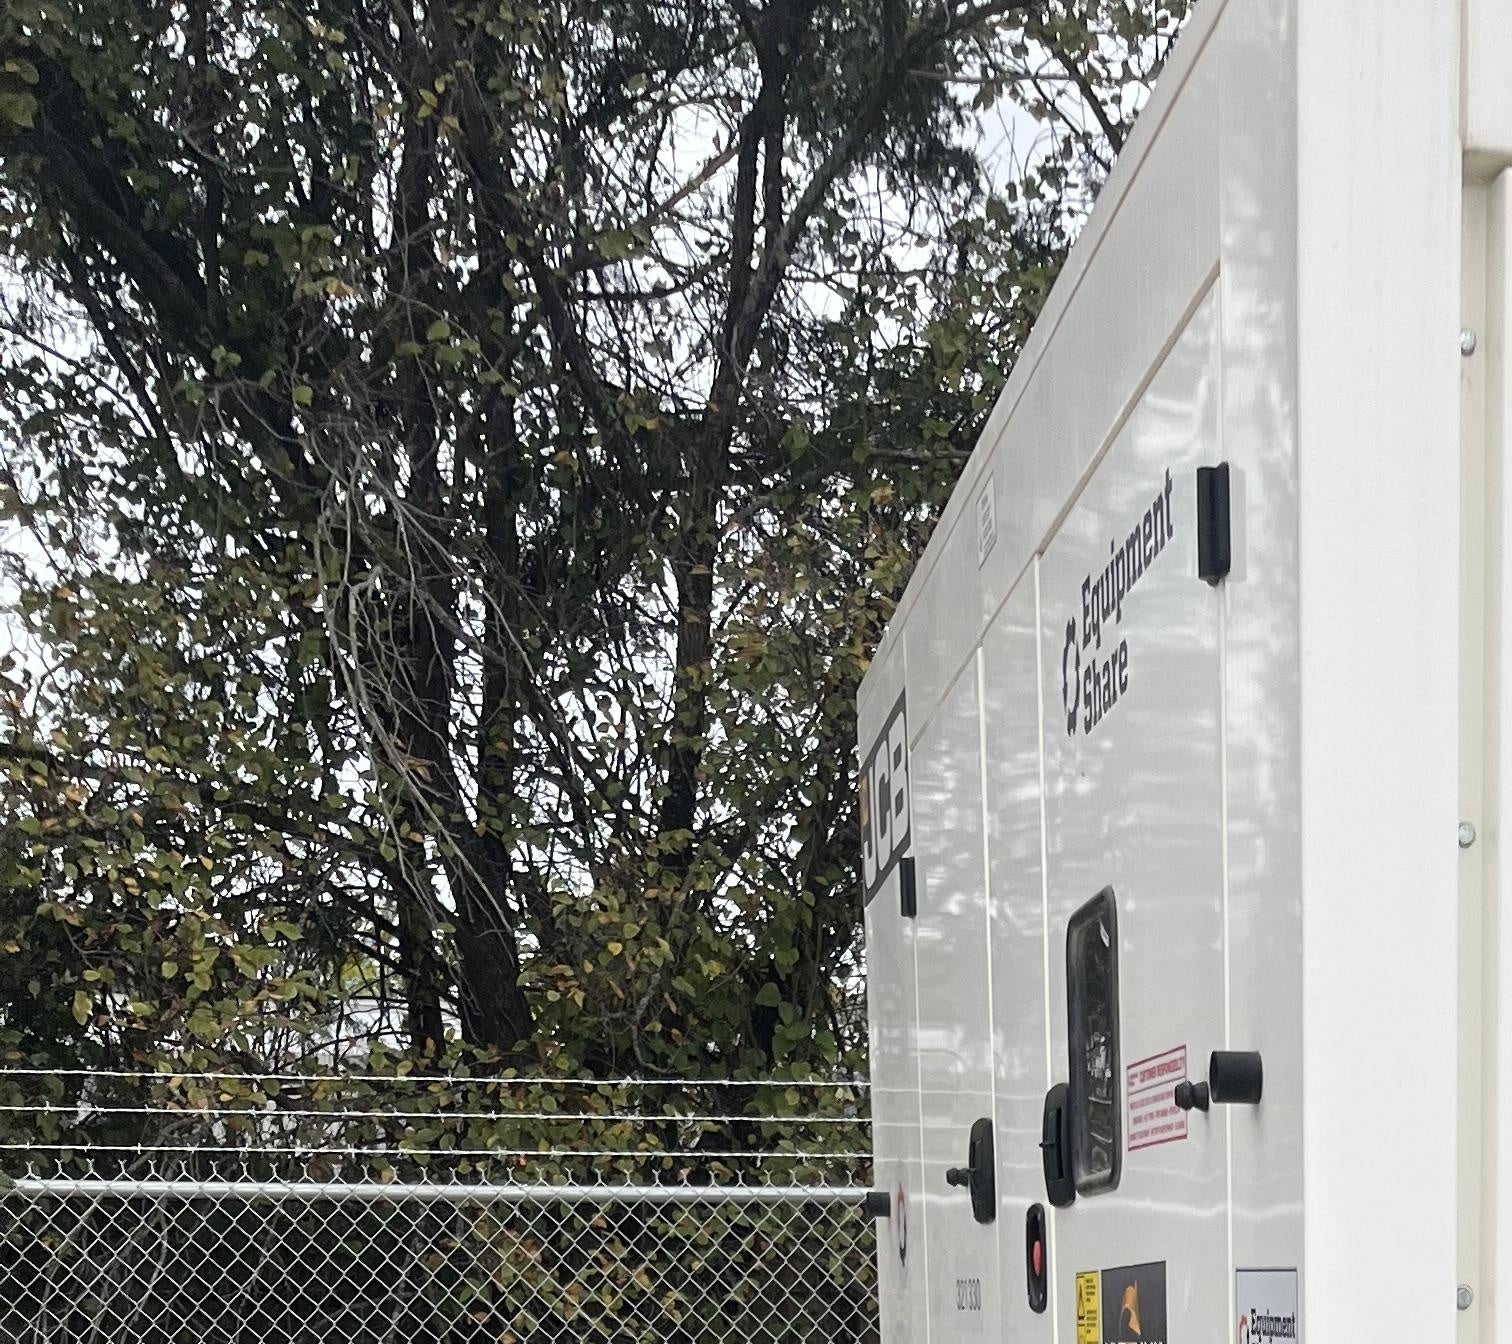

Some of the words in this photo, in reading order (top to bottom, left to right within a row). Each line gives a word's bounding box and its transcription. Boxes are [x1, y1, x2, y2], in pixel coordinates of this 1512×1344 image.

[1082, 467, 1173, 649] Equipment
[1084, 638, 1128, 735] Share
[863, 710, 910, 890] JCB
[1251, 1308, 1295, 1344] Equipment
